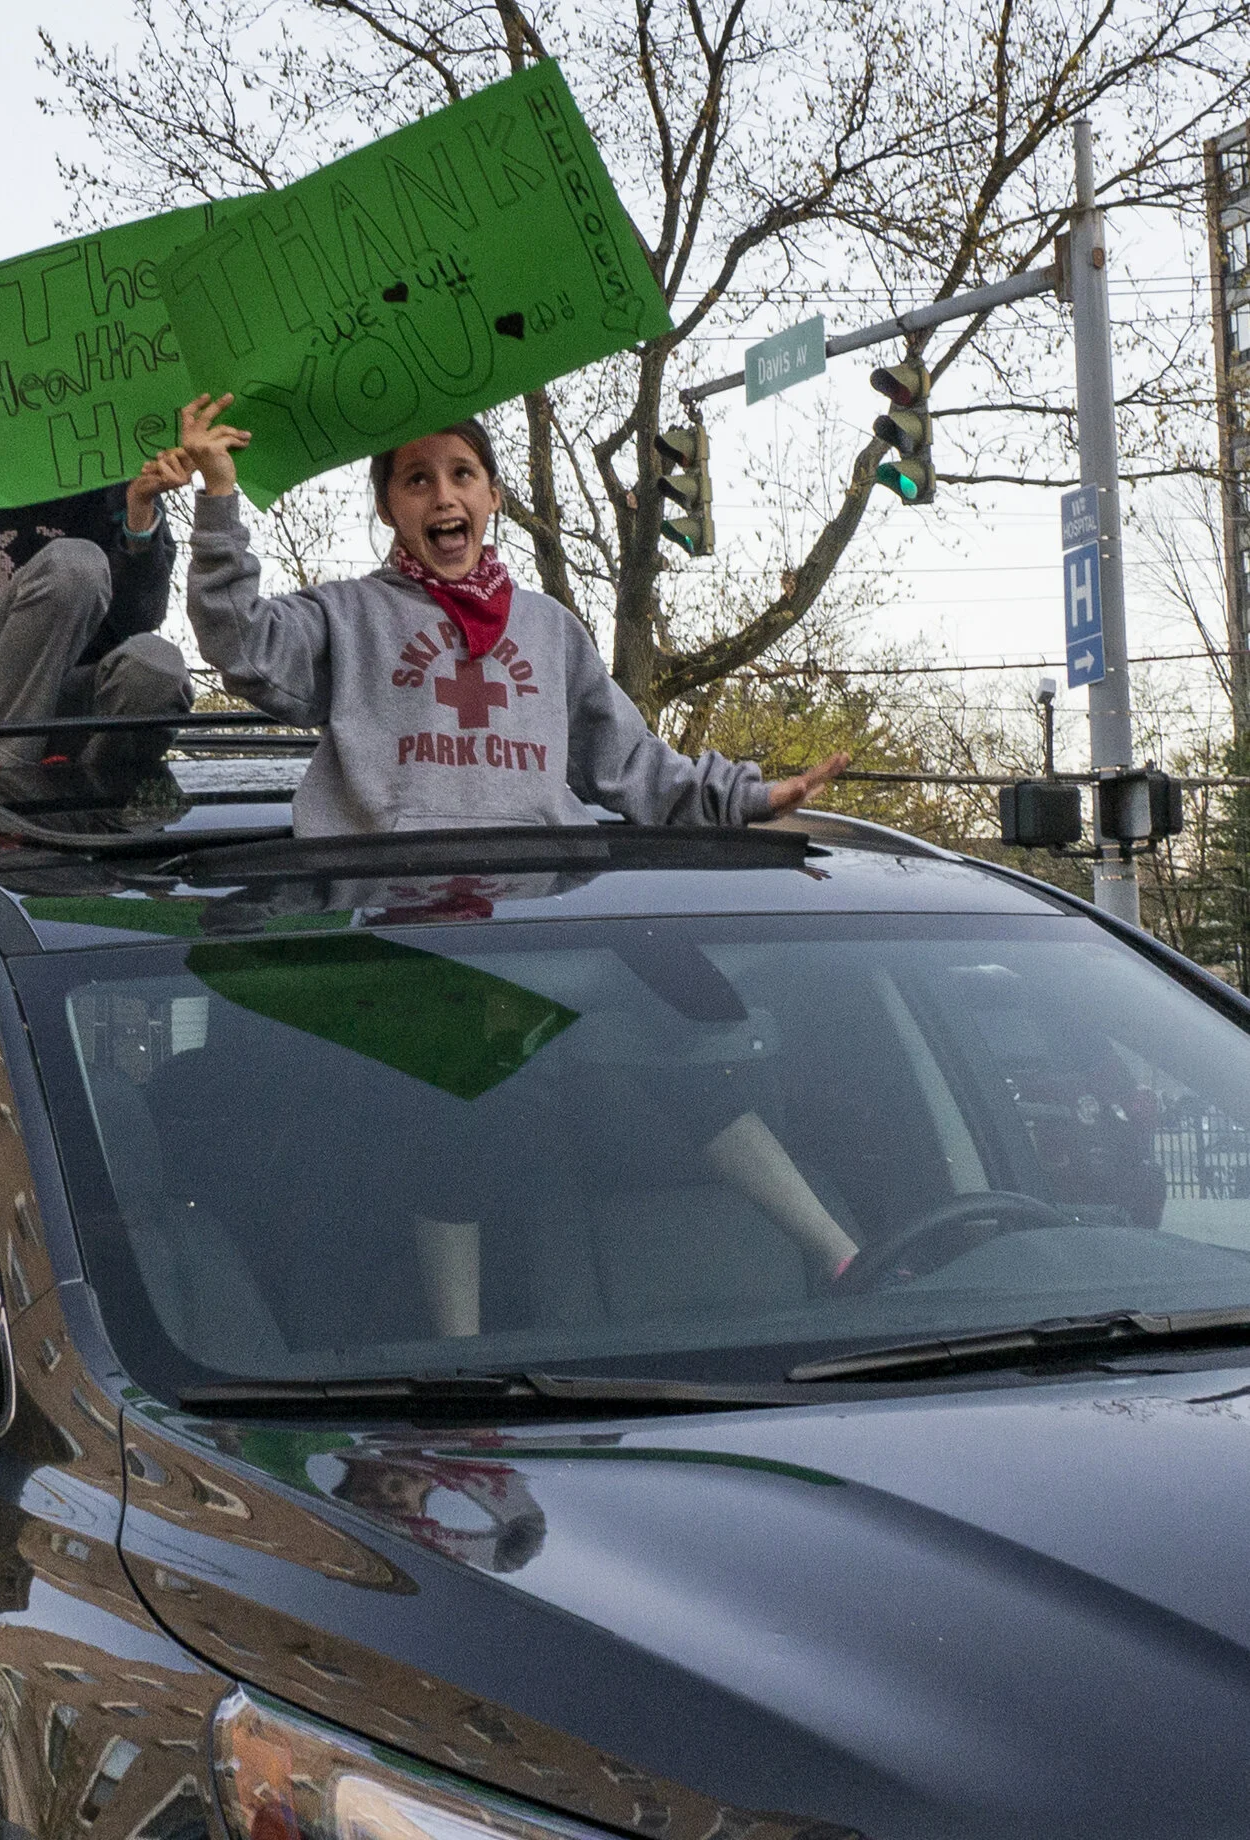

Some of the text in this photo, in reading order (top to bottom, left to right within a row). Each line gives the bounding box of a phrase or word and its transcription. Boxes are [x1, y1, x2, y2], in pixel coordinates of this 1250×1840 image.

[171, 113, 546, 359] THANK
[240, 284, 494, 463] YOU
[758, 343, 808, 385] Davis AV
[1063, 514, 1098, 540] HOSPITAL
[1070, 557, 1093, 628] H
[391, 620, 540, 698] SKI PROL
[398, 731, 548, 772] PARK CITY
